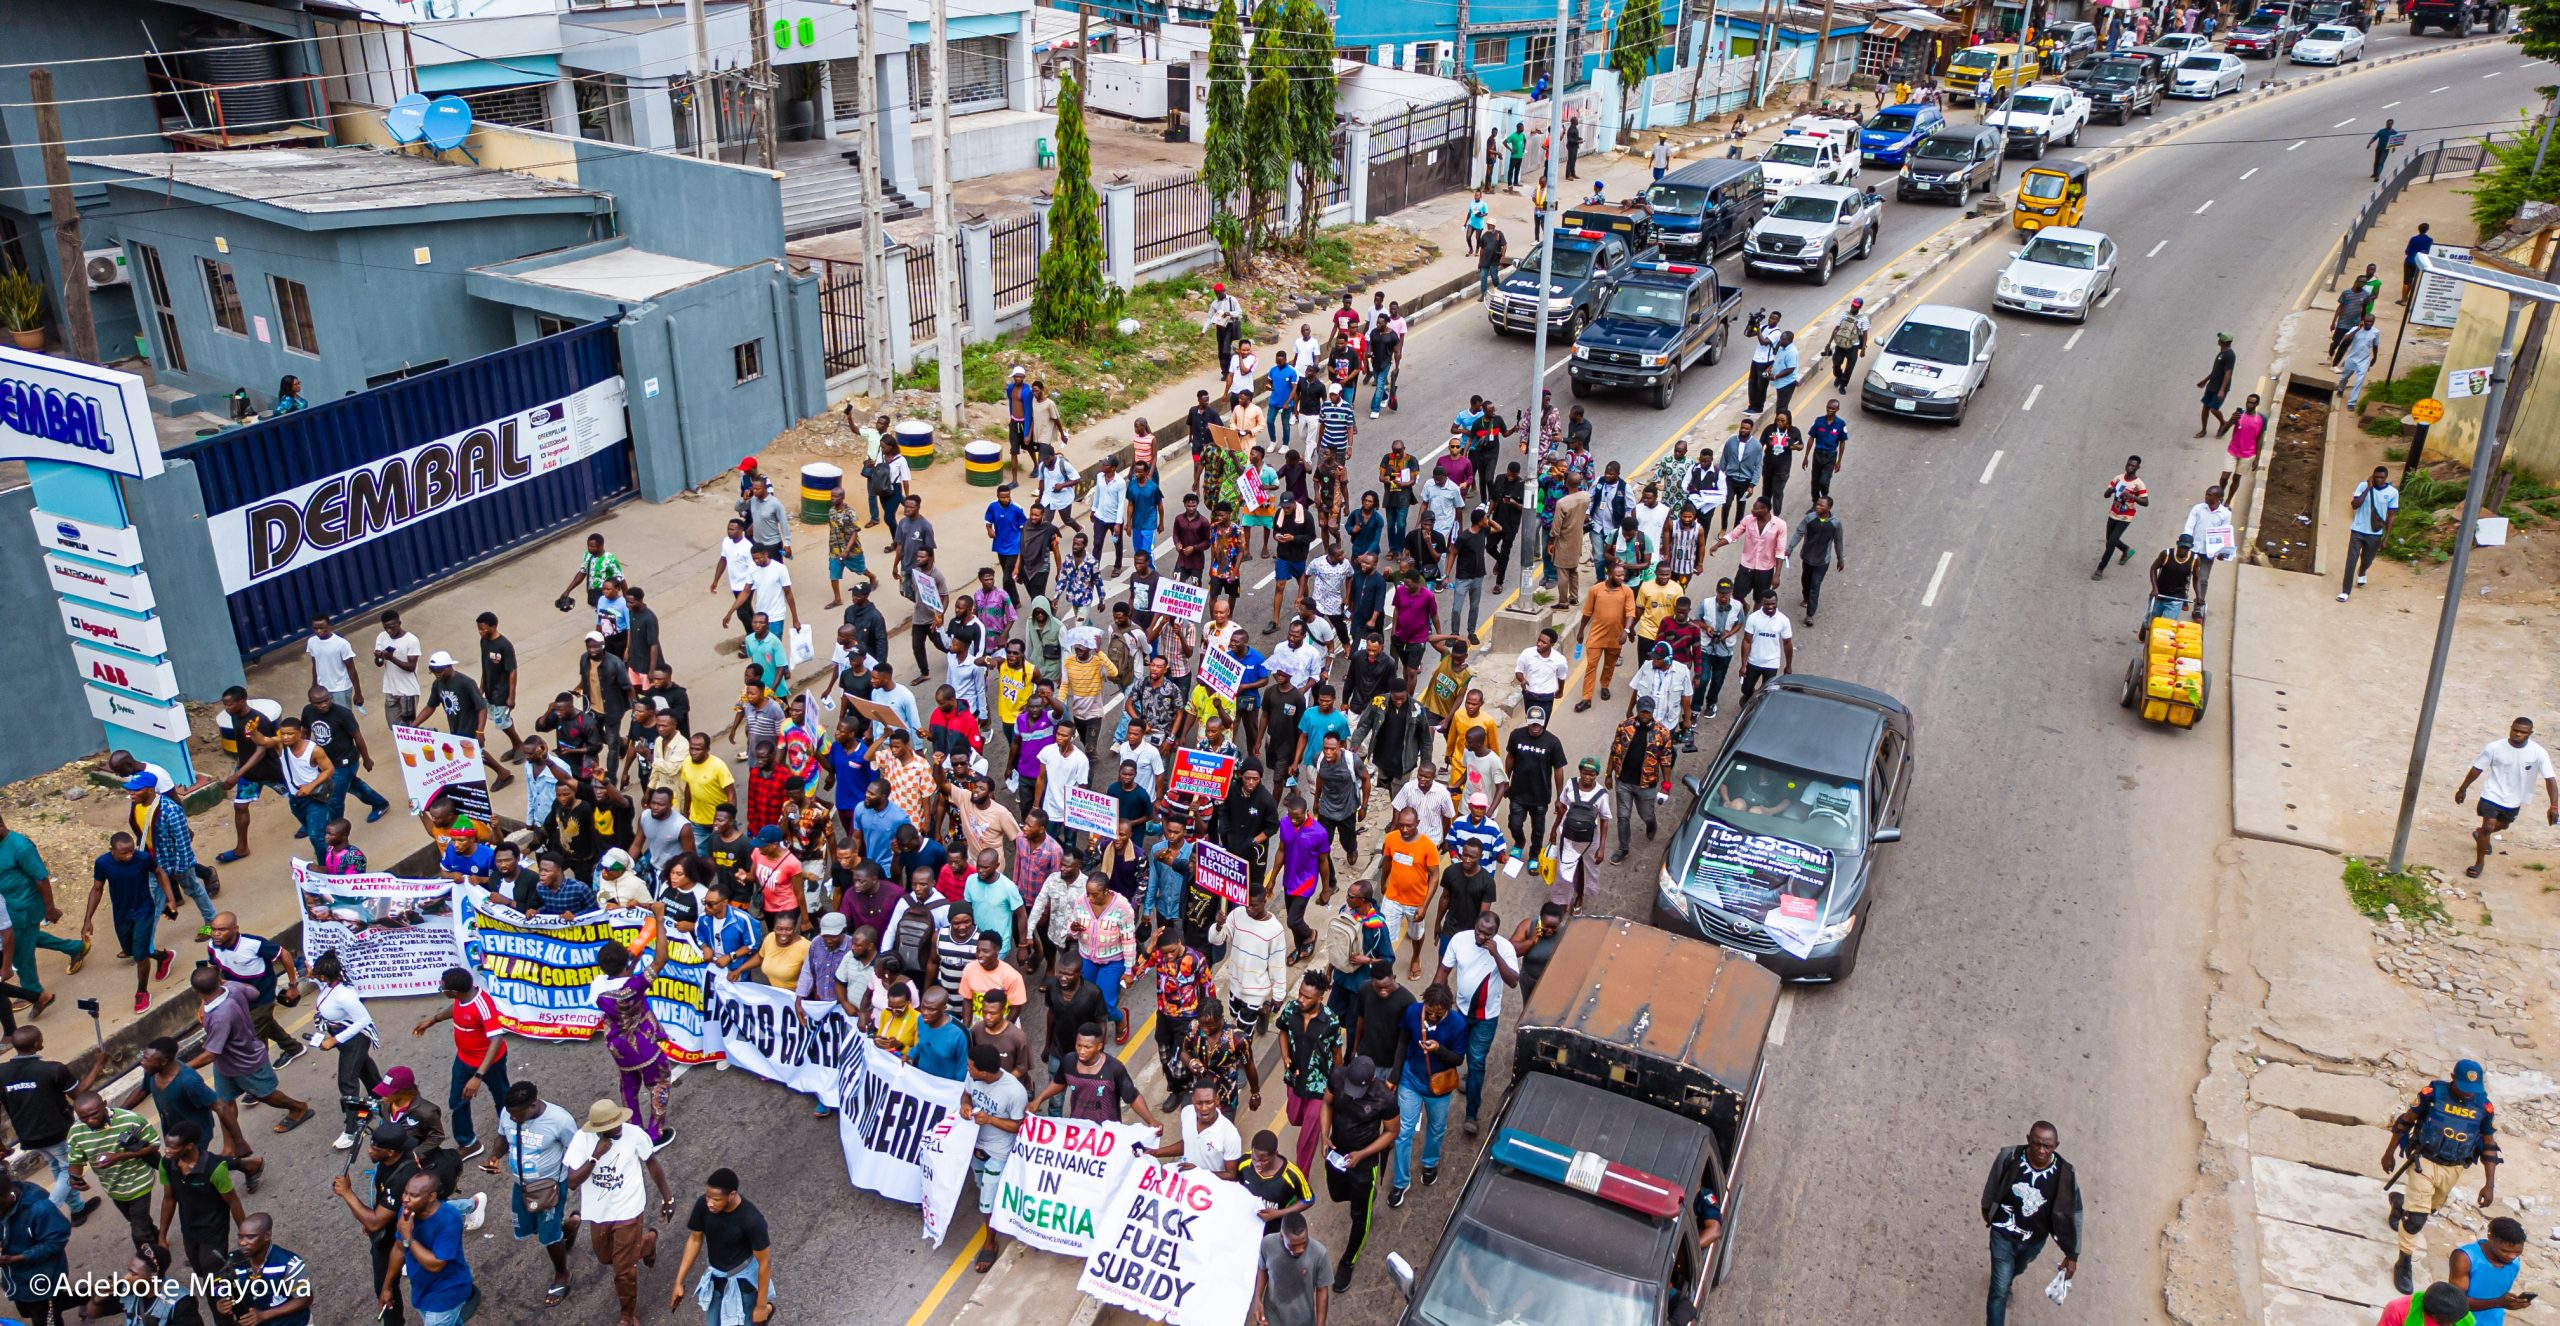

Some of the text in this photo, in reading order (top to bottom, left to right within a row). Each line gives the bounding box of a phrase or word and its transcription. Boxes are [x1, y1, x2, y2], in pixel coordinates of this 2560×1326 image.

[0, 378, 114, 454] EMBAL
[543, 460, 557, 471] ABB
[246, 418, 531, 580] DEMBAL
[1162, 589, 1203, 605] ATTACKS ON
[1172, 584, 1197, 595] END ALL
[1159, 596, 1203, 612] DEMOCRATIC
[1166, 606, 1192, 617] RIGHTS
[80, 618, 118, 639] legrand
[1206, 656, 1238, 684] ECONOMIC
[1209, 646, 1241, 675] TINUBU'S
[93, 661, 128, 687] ABB
[1207, 665, 1232, 687] REFORM
[1002, 686, 1018, 703] 24
[396, 734, 435, 744] HUNGRY
[397, 727, 432, 737] WE ARE
[422, 762, 472, 787] OUR GENERATIONS
[425, 765, 447, 778] PLEASE
[447, 773, 462, 784] COME
[1192, 764, 1215, 774] NEW
[1072, 788, 1111, 806] REVERSE
[1176, 782, 1221, 796] NIGERIA
[1711, 830, 1719, 838] I
[1720, 831, 1743, 842] be
[1205, 846, 1240, 871] REVERSE
[1199, 855, 1246, 884] ELECTRICITY
[327, 877, 393, 885] MOVEMENT
[1198, 868, 1224, 893] TARIFF
[1225, 881, 1247, 903] NOW
[364, 952, 416, 961] ELECTRICITY
[543, 939, 567, 965] ALL
[400, 963, 447, 971] EDUCATION
[510, 959, 540, 983] ALL
[672, 1047, 685, 1058] and
[6, 1082, 37, 1092] PRESS
[973, 1089, 998, 1111] PENN
[2444, 1103, 2477, 1119] LNSC
[1018, 1117, 1116, 1157] ND BAD
[1037, 1170, 1062, 1195] IN
[1001, 1181, 1095, 1239] NIGERIA
[1127, 1194, 1199, 1241] BACK
[1116, 1224, 1181, 1272] FUEL
[1089, 1250, 1196, 1307] SUBIDY
